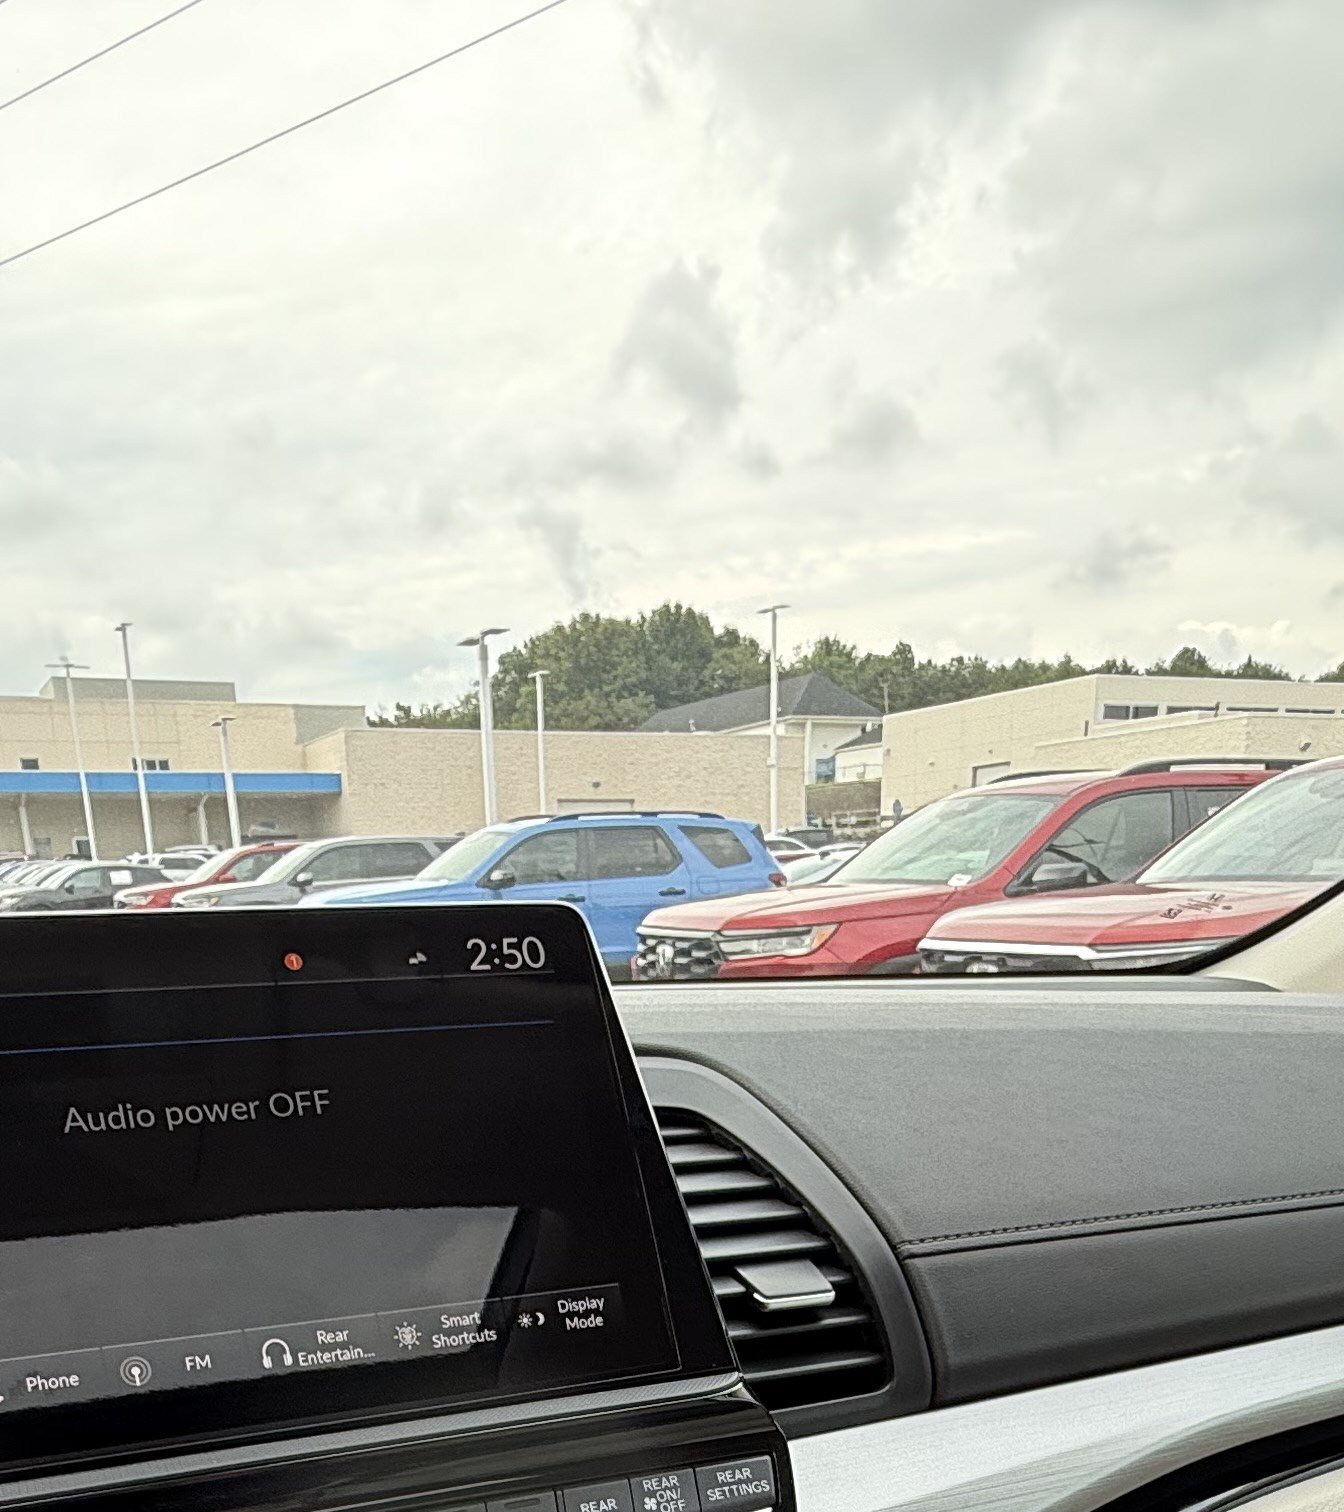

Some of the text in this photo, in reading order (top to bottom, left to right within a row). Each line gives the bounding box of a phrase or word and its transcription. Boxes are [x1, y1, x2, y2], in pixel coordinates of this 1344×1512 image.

[466, 936, 546, 972] 2:50
[63, 1088, 330, 1133] Audio power OFF
[557, 1294, 605, 1316] Display
[440, 1311, 481, 1329] Smart
[565, 1311, 604, 1331] Mode
[316, 1327, 349, 1345] Rear
[431, 1325, 497, 1349] Shortcuts
[185, 1353, 212, 1371] FM
[297, 1344, 376, 1367] Entertain...
[25, 1370, 80, 1391] Phone
[642, 1475, 679, 1492] REAR
[715, 1467, 752, 1484] REAR
[656, 1488, 681, 1503] ON/
[706, 1479, 770, 1501] SETTINGS
